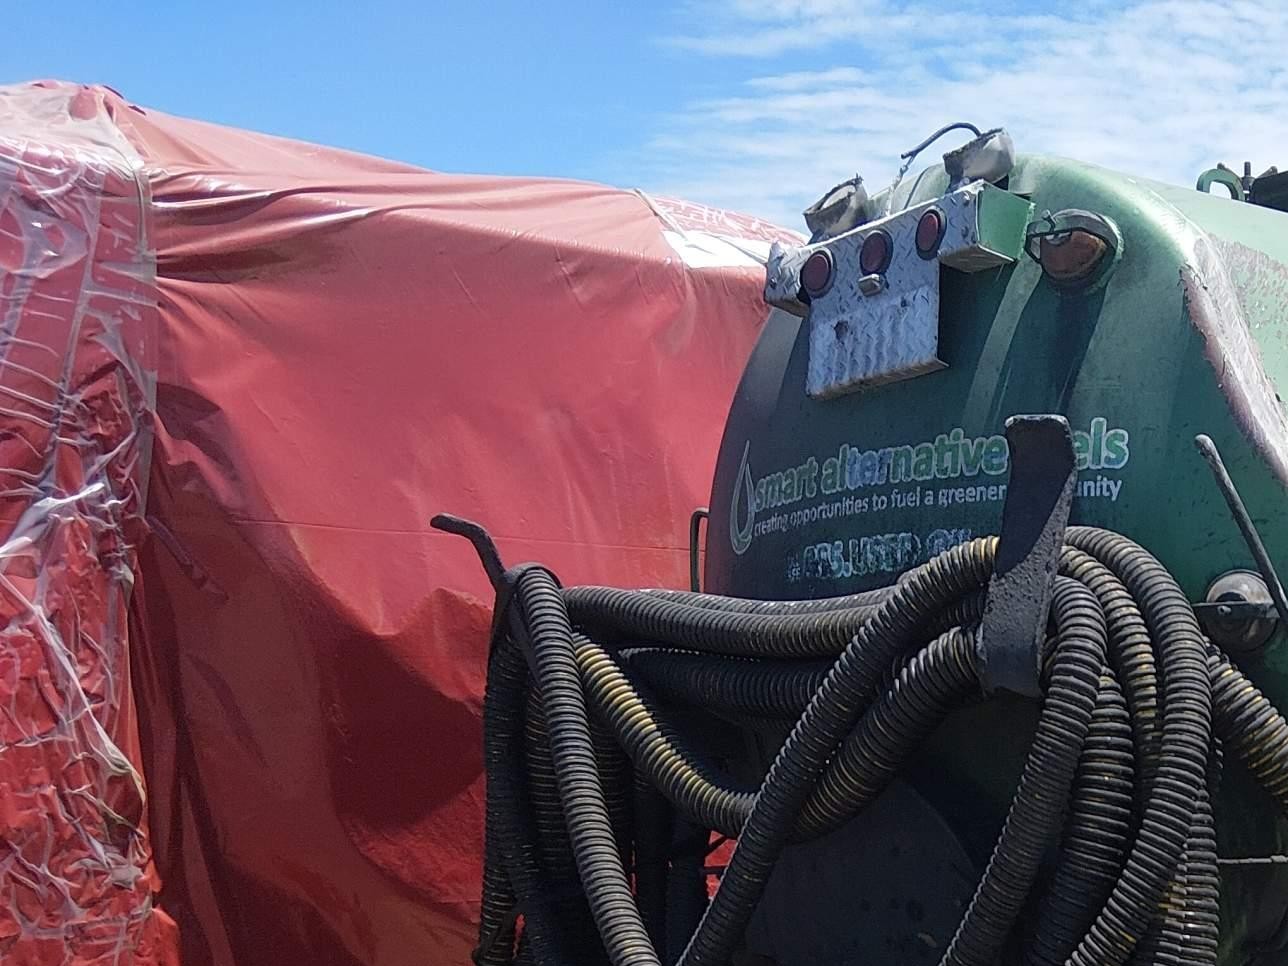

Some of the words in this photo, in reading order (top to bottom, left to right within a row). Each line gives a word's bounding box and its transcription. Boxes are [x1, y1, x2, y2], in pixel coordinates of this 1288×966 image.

[755, 456, 819, 513] smart
[820, 428, 1010, 495] alternative
[1072, 417, 1129, 471] els
[754, 512, 788, 537] creating
[790, 495, 869, 527] opportunities
[872, 492, 888, 512] to
[891, 486, 921, 508] fuel
[924, 489, 934, 506] a
[938, 484, 1008, 508] greener
